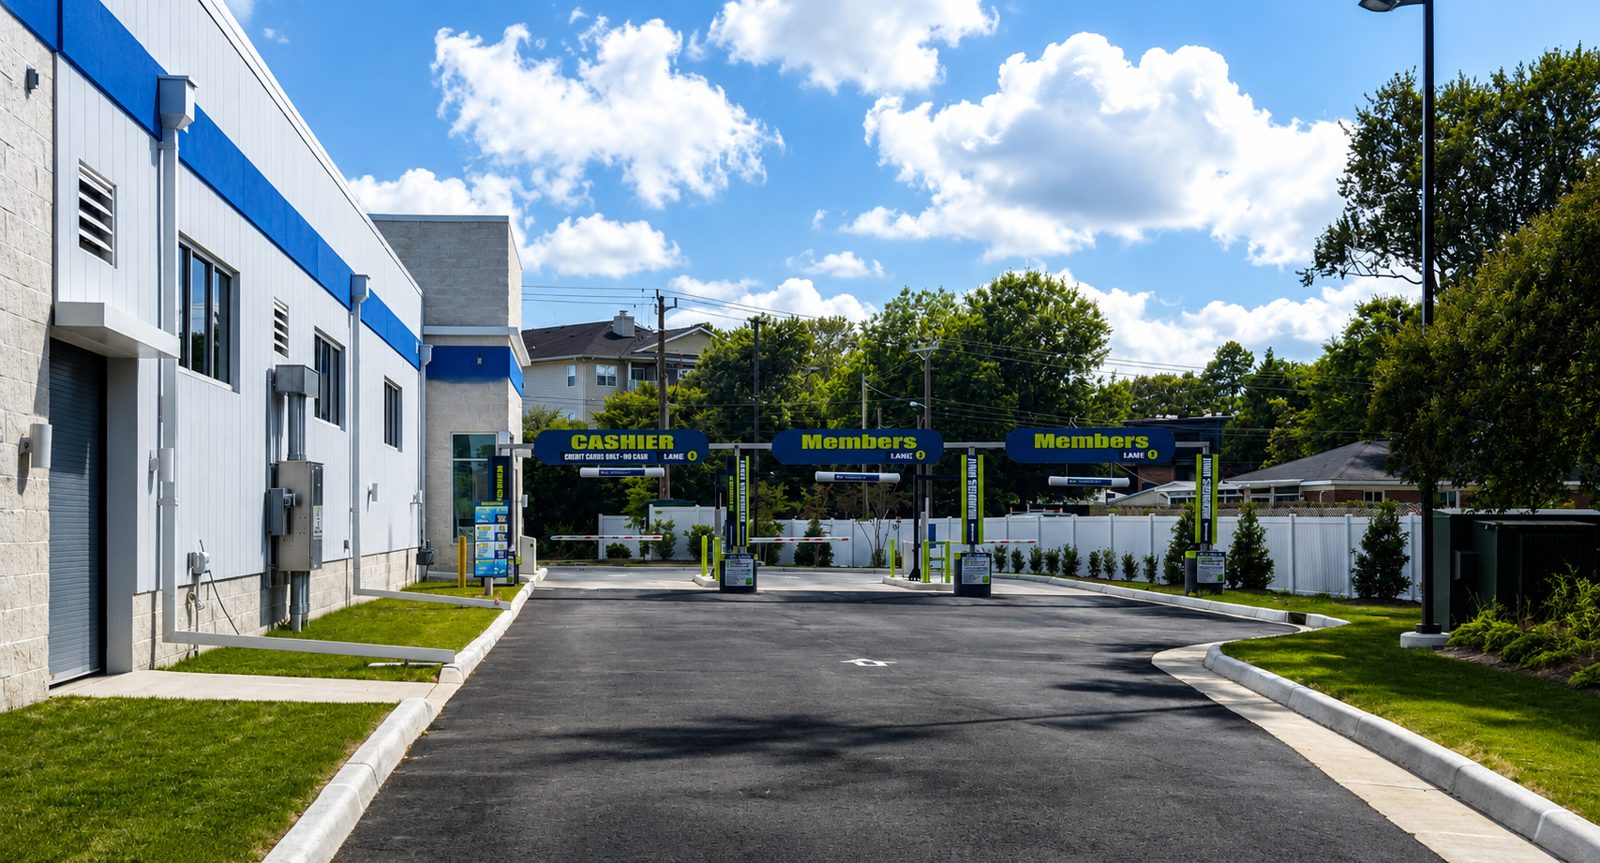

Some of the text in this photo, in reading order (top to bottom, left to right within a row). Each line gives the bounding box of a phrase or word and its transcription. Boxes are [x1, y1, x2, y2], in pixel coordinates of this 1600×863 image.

[571, 434, 674, 450] CASHIER
[801, 433, 918, 450] Members
[1034, 432, 1149, 449] Members
